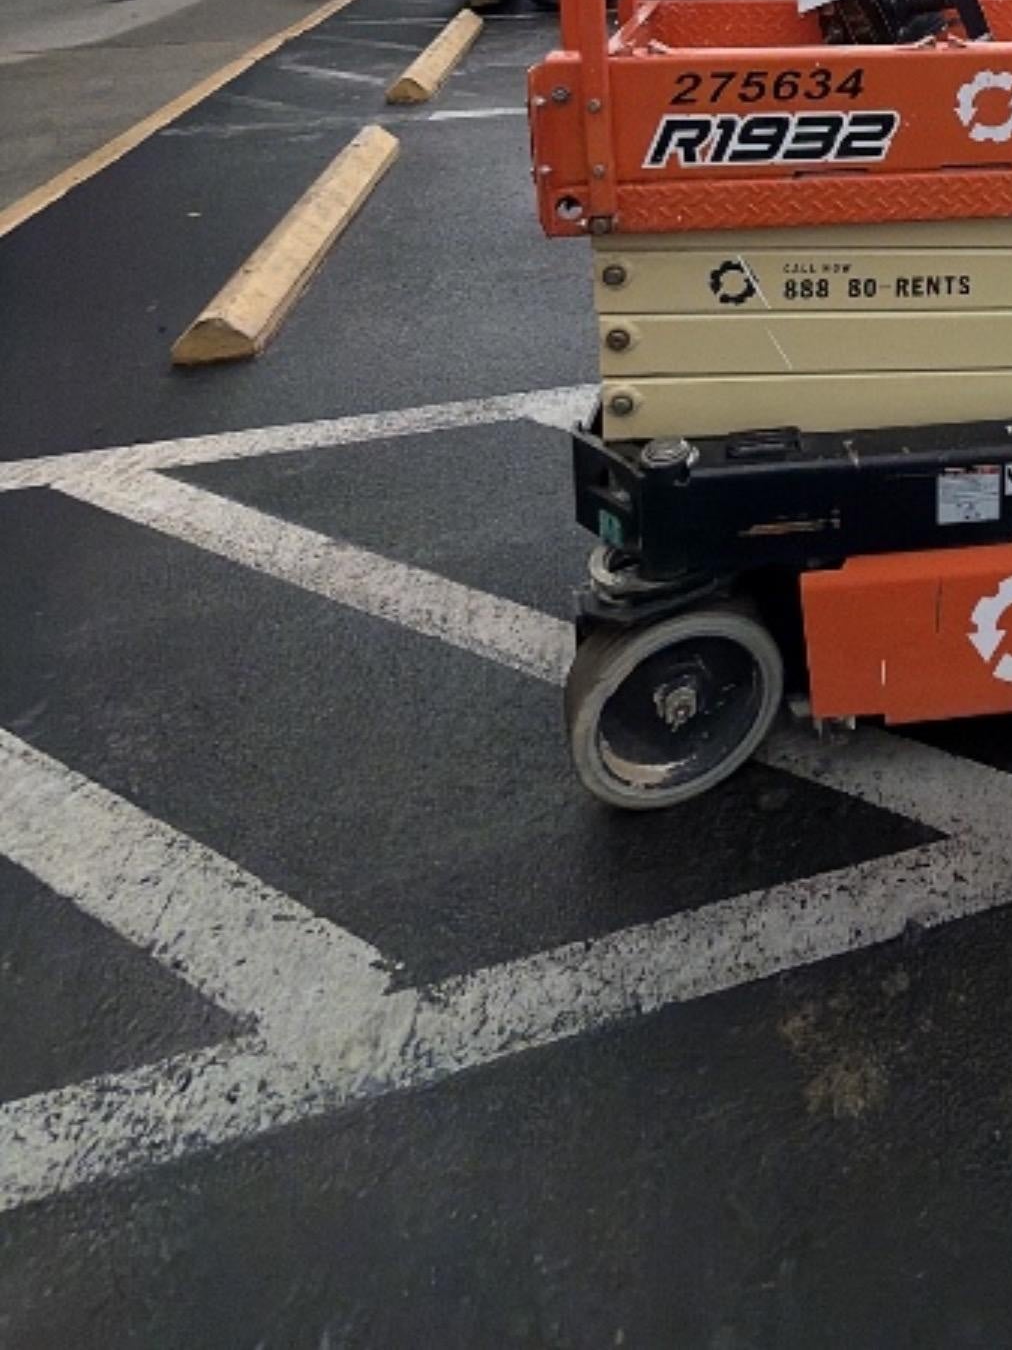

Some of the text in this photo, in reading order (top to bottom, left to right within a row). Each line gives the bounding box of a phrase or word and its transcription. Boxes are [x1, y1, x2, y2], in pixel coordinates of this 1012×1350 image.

[670, 68, 865, 106] 275634
[641, 110, 901, 169] R1932
[784, 278, 829, 300] 888
